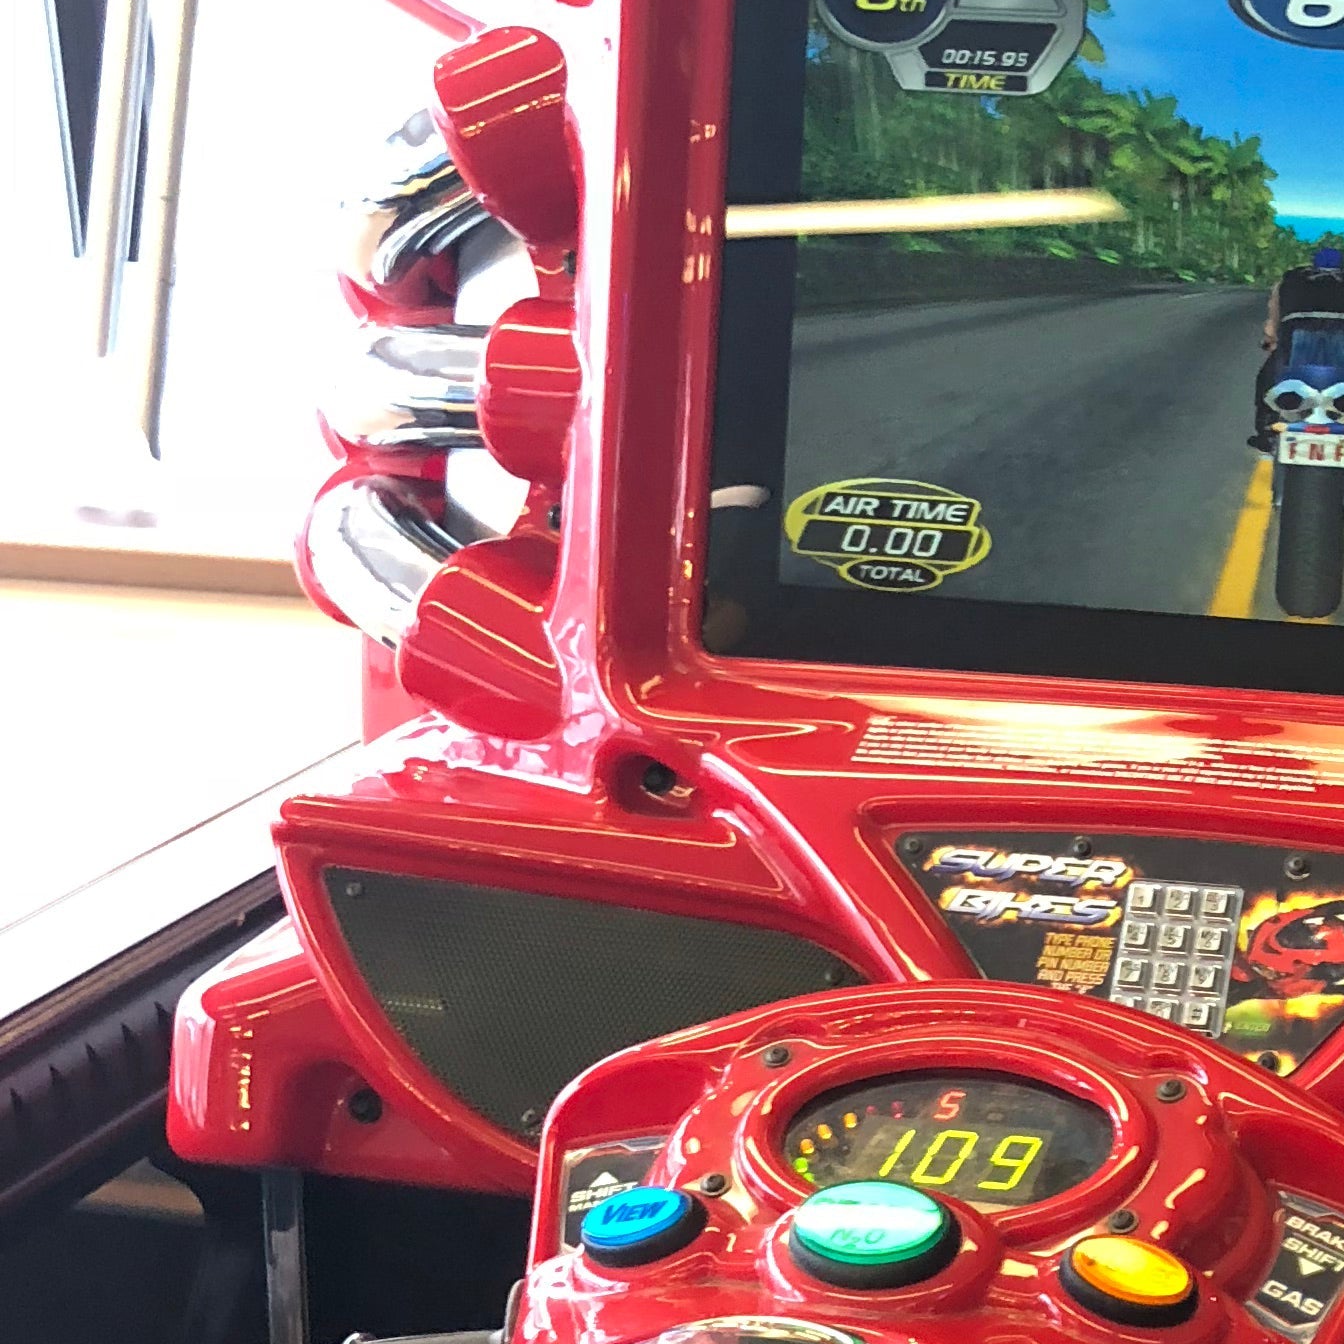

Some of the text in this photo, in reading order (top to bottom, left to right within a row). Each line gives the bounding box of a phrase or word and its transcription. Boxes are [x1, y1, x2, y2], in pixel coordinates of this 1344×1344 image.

[945, 72, 1006, 91] TIME
[824, 495, 970, 523] AIR TIME
[841, 524, 943, 557] 0.00
[859, 565, 926, 583] TOTAL
[930, 848, 1129, 888] SUPER
[946, 888, 1118, 924] BIKES
[1042, 945, 1094, 960] NUMBER
[1075, 935, 1117, 949] PHONE
[1037, 969, 1107, 986] AND PRESS
[1060, 959, 1111, 973] NUMBER
[932, 1090, 968, 1122] 5
[878, 1129, 1043, 1191] 109
[569, 1181, 639, 1204] SHIFT
[601, 1200, 669, 1226] VIEW
[1261, 1279, 1325, 1317] GAS
